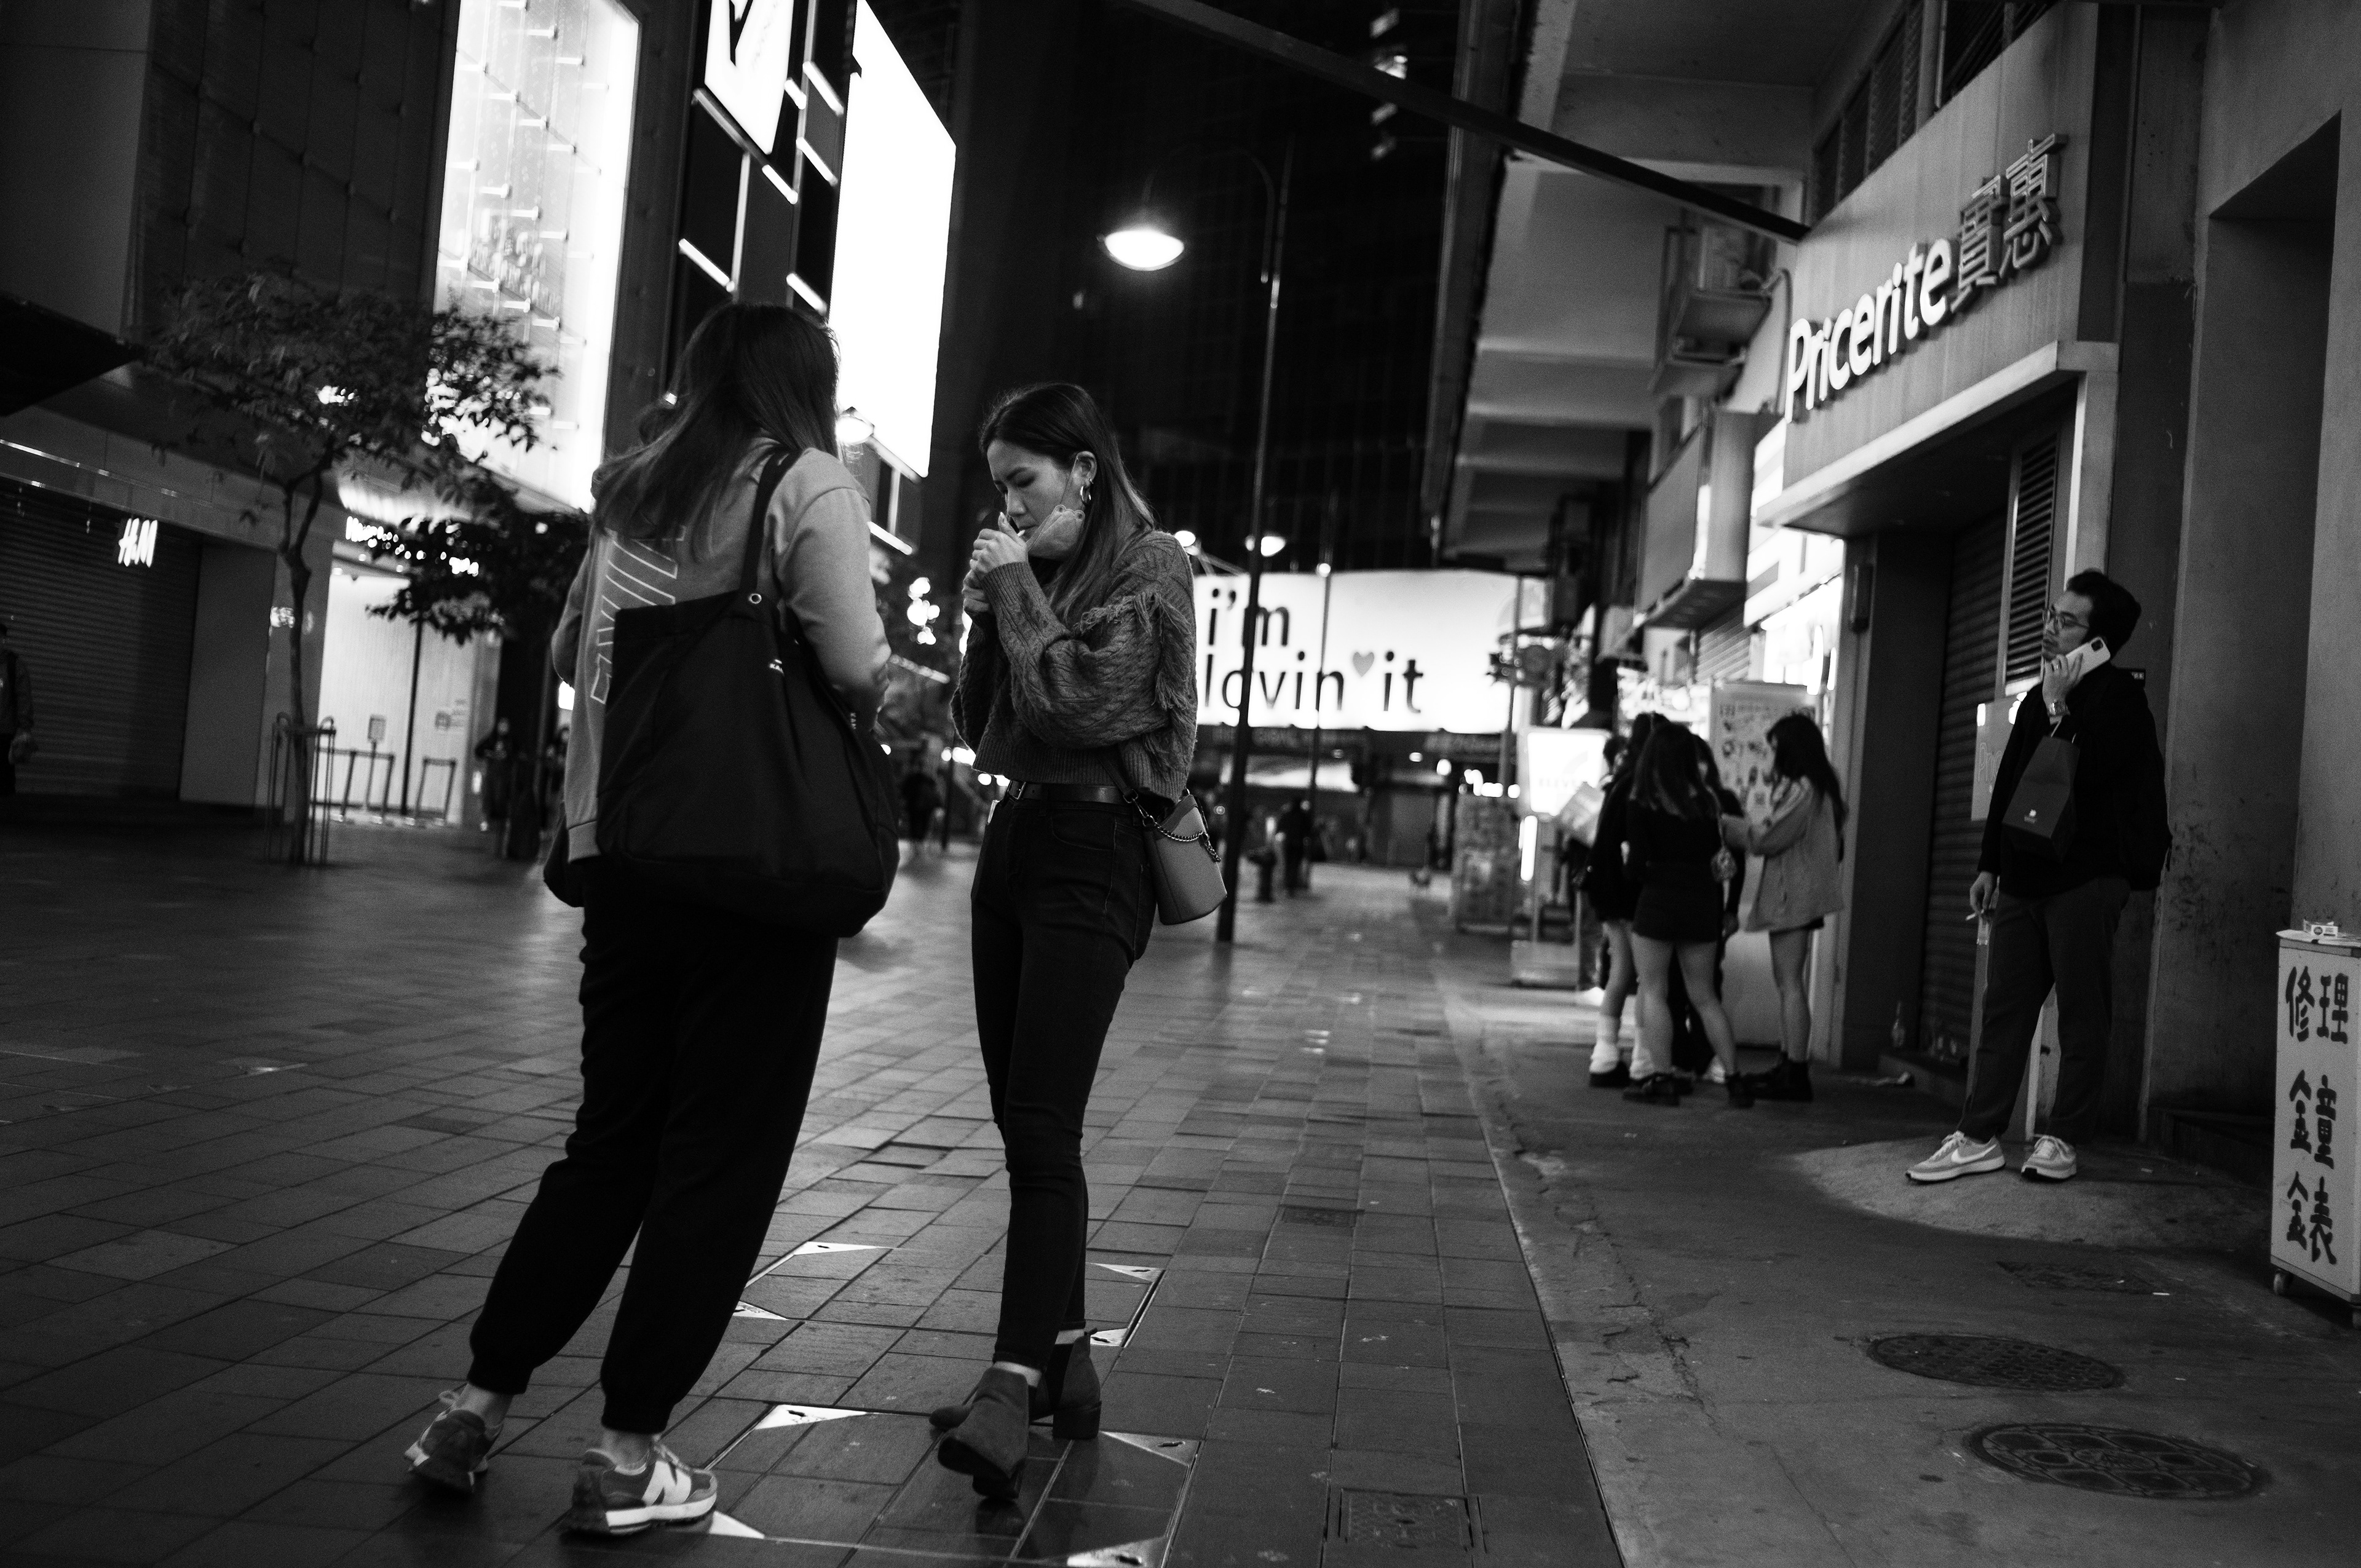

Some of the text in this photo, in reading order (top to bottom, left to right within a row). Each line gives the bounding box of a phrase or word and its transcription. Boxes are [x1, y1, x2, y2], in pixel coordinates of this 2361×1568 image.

[1784, 133, 2055, 424] Pricerite 實惠
[1209, 588, 1290, 647] i'm
[1204, 651, 1423, 713] lovin it
